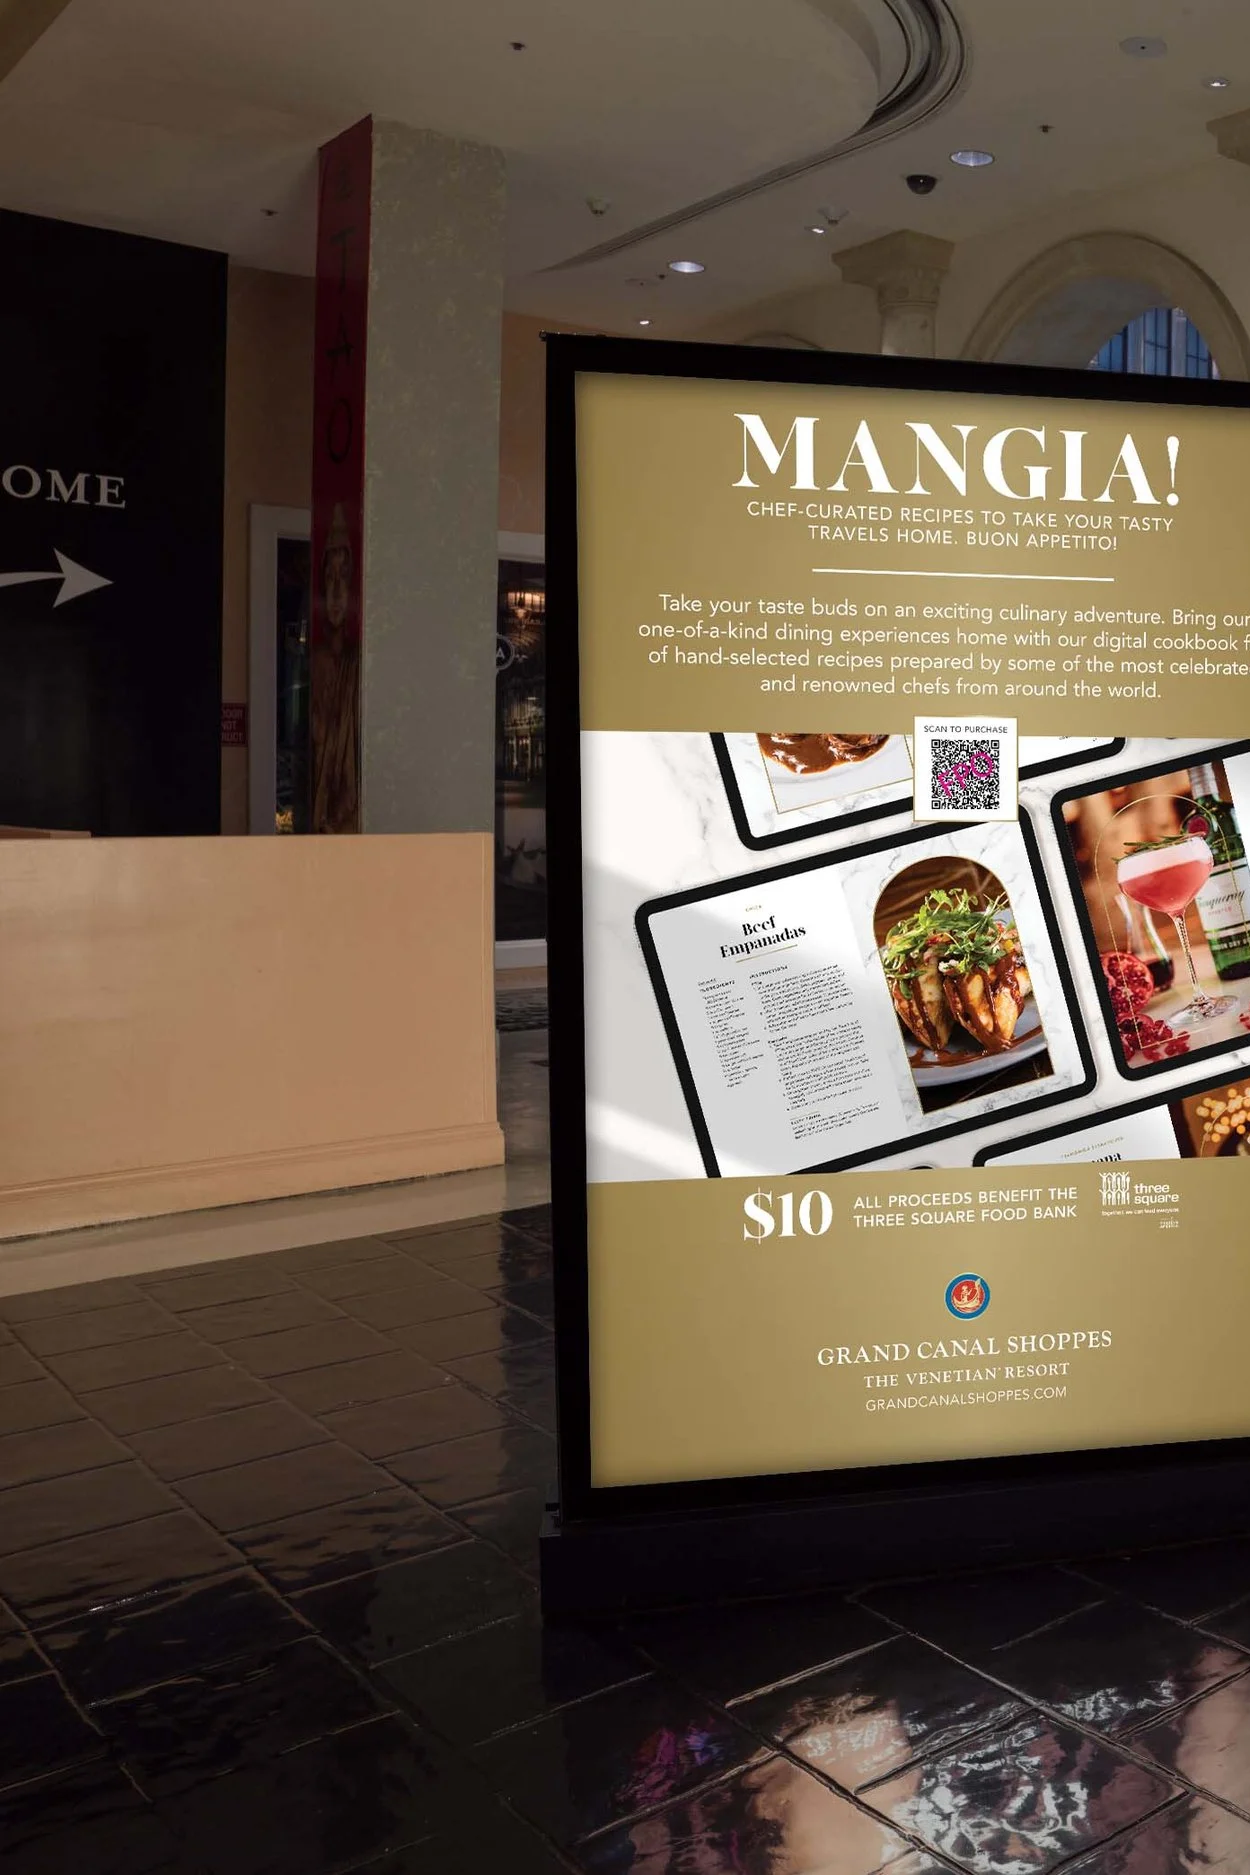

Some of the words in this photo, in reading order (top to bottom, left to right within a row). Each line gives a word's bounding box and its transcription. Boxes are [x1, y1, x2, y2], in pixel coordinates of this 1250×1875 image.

[732, 414, 1180, 506] MANGIA!
[747, 501, 893, 521] CHEF-CURATED
[901, 508, 974, 525] RECIPES
[981, 511, 1006, 526] TO
[1013, 512, 1058, 528] TAKE
[1065, 515, 1113, 530] YOUR
[1119, 517, 1174, 532] TASTY
[808, 525, 889, 543] TRAVELS
[898, 529, 958, 545] HOME.
[967, 531, 1019, 547] BUON
[1026, 534, 1117, 551] APPETITO!
[659, 594, 702, 613] Take
[710, 600, 752, 617] your
[758, 599, 805, 615] taste
[812, 597, 857, 617] buds
[865, 604, 888, 617] on
[895, 605, 916, 618] an
[923, 602, 993, 625] exciting
[1000, 603, 1068, 627] culinary
[1074, 605, 1165, 625] adventure.
[1173, 609, 1217, 631] Bring
[638, 619, 768, 640] one-of-a-kind
[776, 622, 833, 646] dining
[840, 626, 950, 647] experiences
[957, 627, 1008, 645] home
[1014, 628, 1051, 646] with
[1058, 635, 1087, 647] our
[1094, 630, 1147, 653] digital
[1153, 632, 1239, 651] cookbook
[648, 645, 669, 664] of
[676, 645, 810, 667] hand-selected
[817, 650, 884, 672] recipes
[891, 653, 974, 674] prepared
[981, 653, 1002, 675] by
[1008, 658, 1056, 672] some
[1063, 654, 1082, 672] of
[1086, 655, 1115, 673] the
[1121, 659, 1164, 674] most
[760, 673, 796, 692] and
[802, 675, 895, 694] renowned
[903, 676, 951, 695] chefs
[956, 677, 999, 696] from
[1005, 679, 1067, 697] around
[1073, 679, 1102, 698] the
[1107, 681, 1162, 699] world.
[924, 725, 948, 733] SCAN
[950, 725, 962, 733] TO
[965, 726, 1008, 734] PURCHASE
[937, 752, 994, 798] FPO
[742, 915, 776, 937] Beef
[720, 926, 807, 958] Empanadas
[854, 1196, 882, 1210] ALL
[888, 1192, 973, 1208] PROCEEDS
[978, 1188, 1043, 1204] BENEFIT
[1048, 1186, 1078, 1201] THE
[1134, 1183, 1170, 1195] three
[1134, 1193, 1180, 1206] square
[743, 1186, 834, 1245] $10
[853, 1213, 905, 1228] THREE
[911, 1209, 976, 1225] SQUARE
[982, 1207, 1028, 1222] FOOD
[1034, 1204, 1077, 1220] BANK
[818, 1343, 911, 1366] GRAND
[917, 1337, 1001, 1360] CANAL
[1007, 1329, 1112, 1354] SHOPPES
[864, 1374, 899, 1389] THE
[906, 1368, 998, 1386] VENETIAN
[1004, 1362, 1070, 1379] RESORT
[865, 1386, 1067, 1412] GRANDCANALSHOPPES.COM
